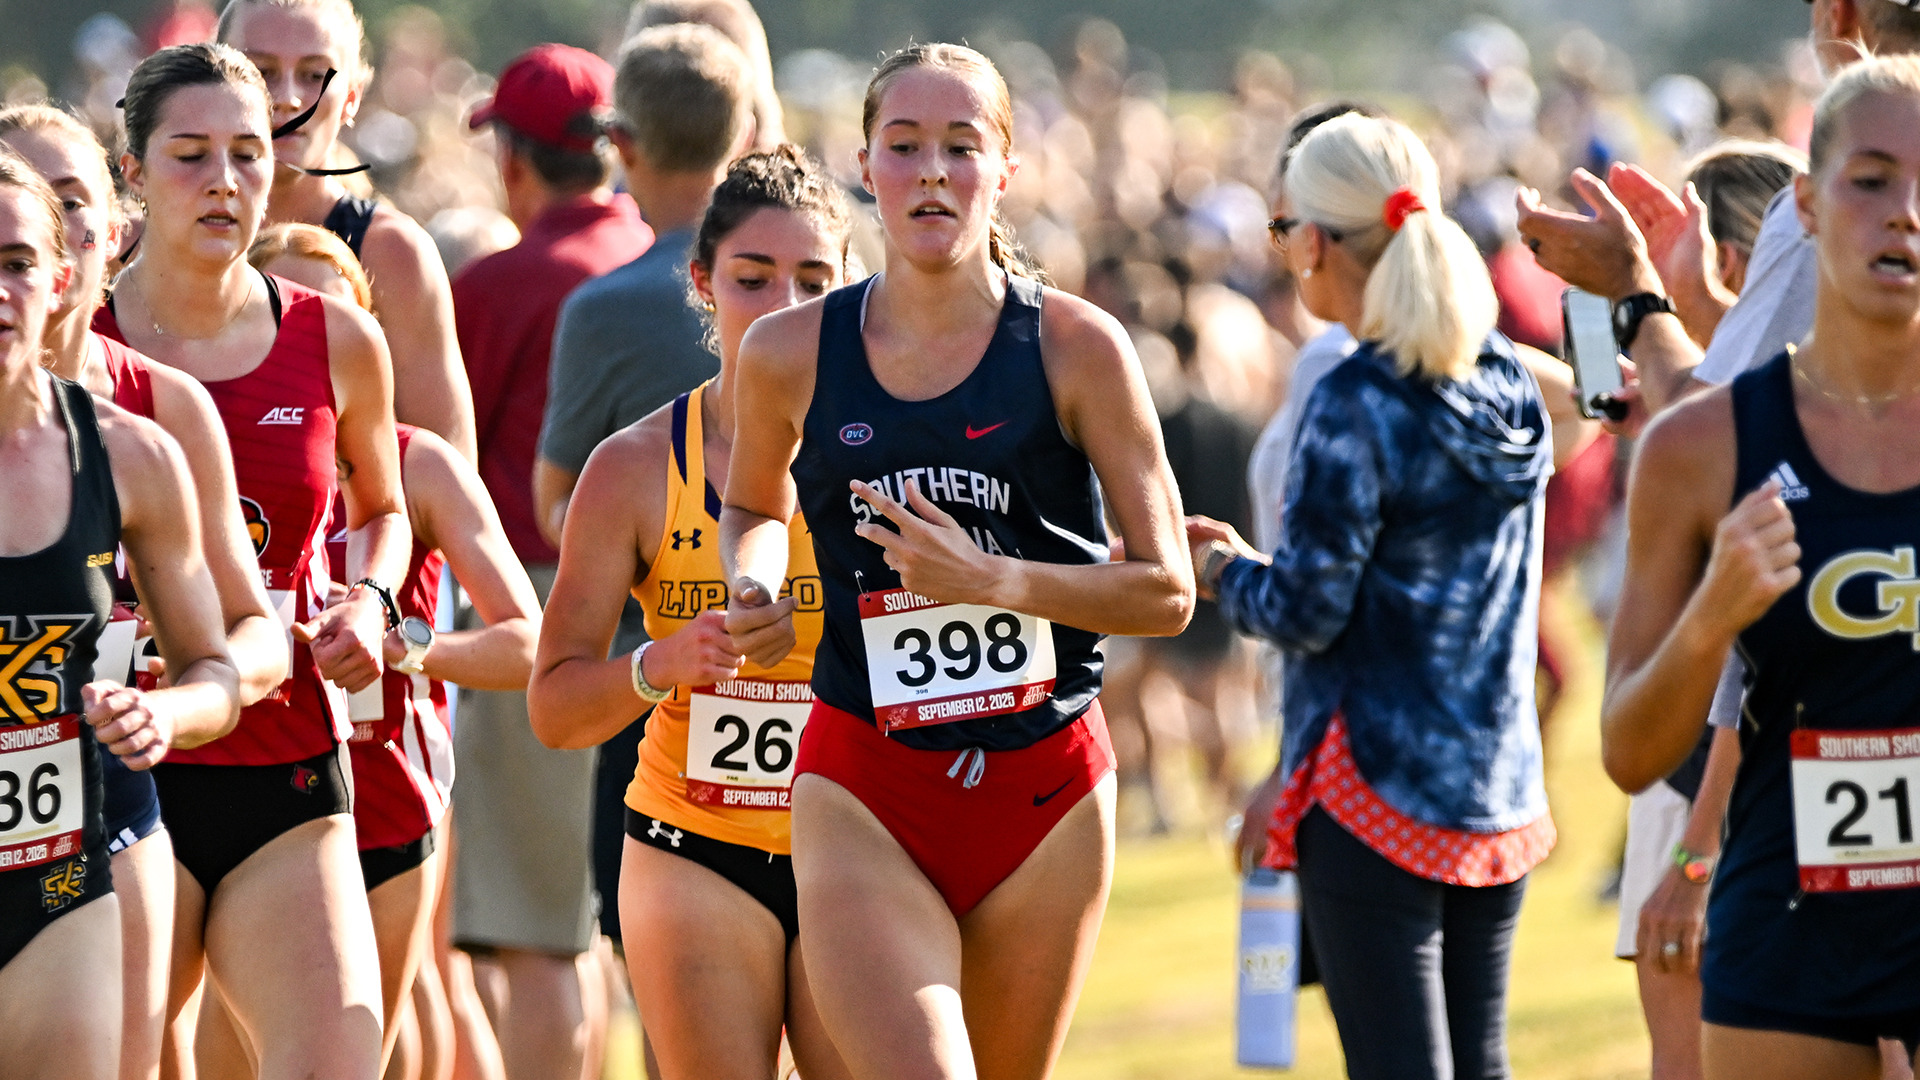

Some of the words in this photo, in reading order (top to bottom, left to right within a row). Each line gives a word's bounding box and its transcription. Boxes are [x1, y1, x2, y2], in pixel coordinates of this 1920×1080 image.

[260, 407, 304, 421] ACC
[846, 428, 866, 439] OVC
[850, 467, 1010, 524] SOUTHERN
[1779, 486, 1809, 500] das
[658, 576, 825, 619] LIPO
[883, 591, 939, 612] SOUTH
[893, 612, 1028, 687] 398
[715, 680, 774, 700] SOUTHERN
[776, 683, 816, 701] SHOW
[918, 698, 975, 721] SEPTEMBER
[975, 696, 989, 712] 12,
[989, 692, 1015, 710] 2025
[0, 722, 60, 750] SHOWCASE
[711, 714, 806, 773] 26
[1819, 736, 1890, 758] SOUTHERN
[723, 789, 777, 806] SEPTEMBER
[1825, 777, 1913, 847] 21
[14, 849, 25, 865] 12,
[26, 844, 47, 862] 2025
[1848, 866, 1914, 887] SEPTEMBER
